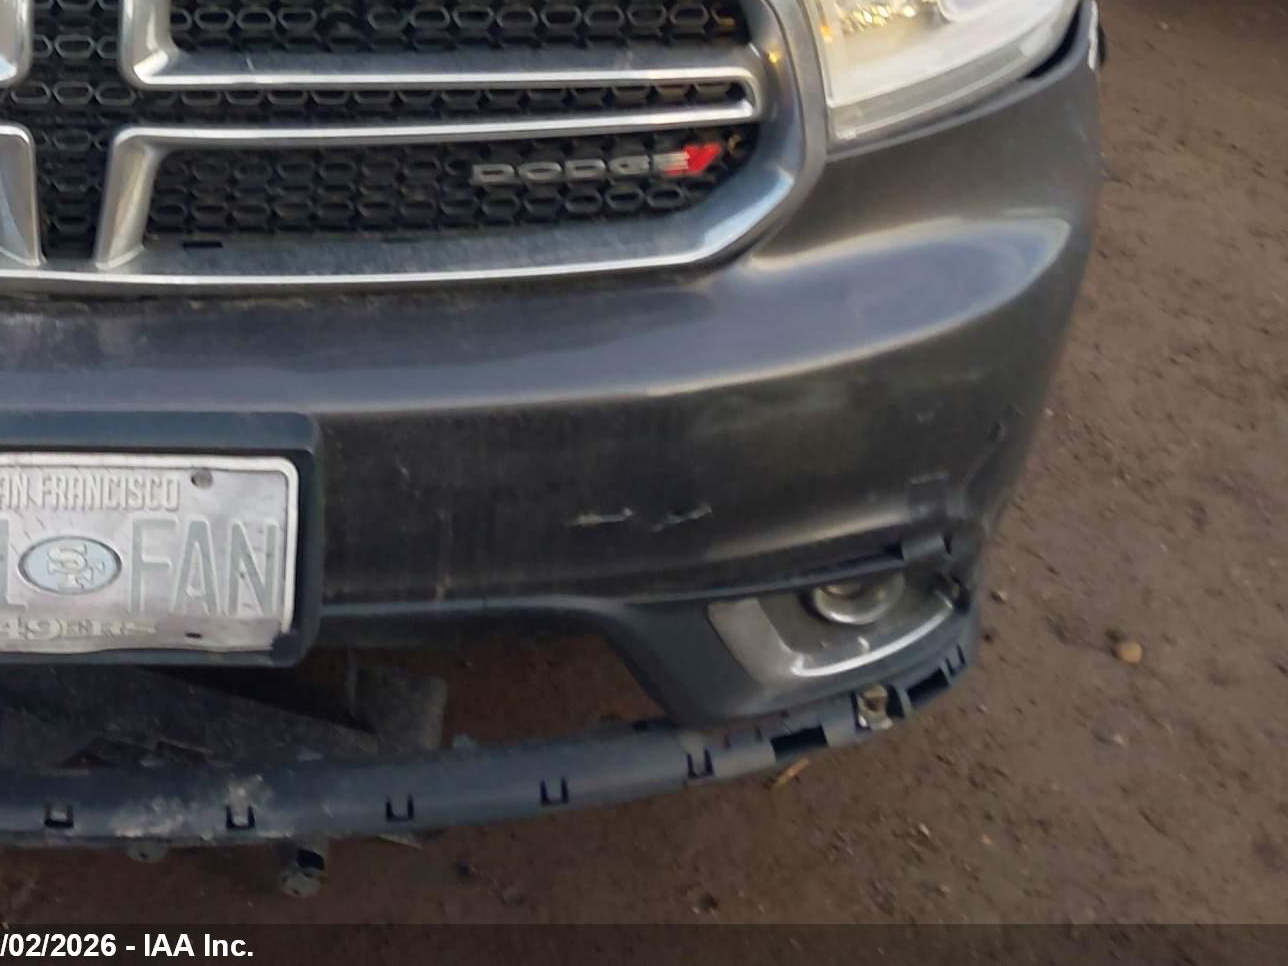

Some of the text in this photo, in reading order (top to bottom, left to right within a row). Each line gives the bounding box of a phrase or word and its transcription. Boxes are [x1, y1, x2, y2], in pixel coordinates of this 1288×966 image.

[470, 148, 691, 185] DODGE
[38, 471, 181, 512] FRANCISCO
[128, 518, 279, 617] FAN
